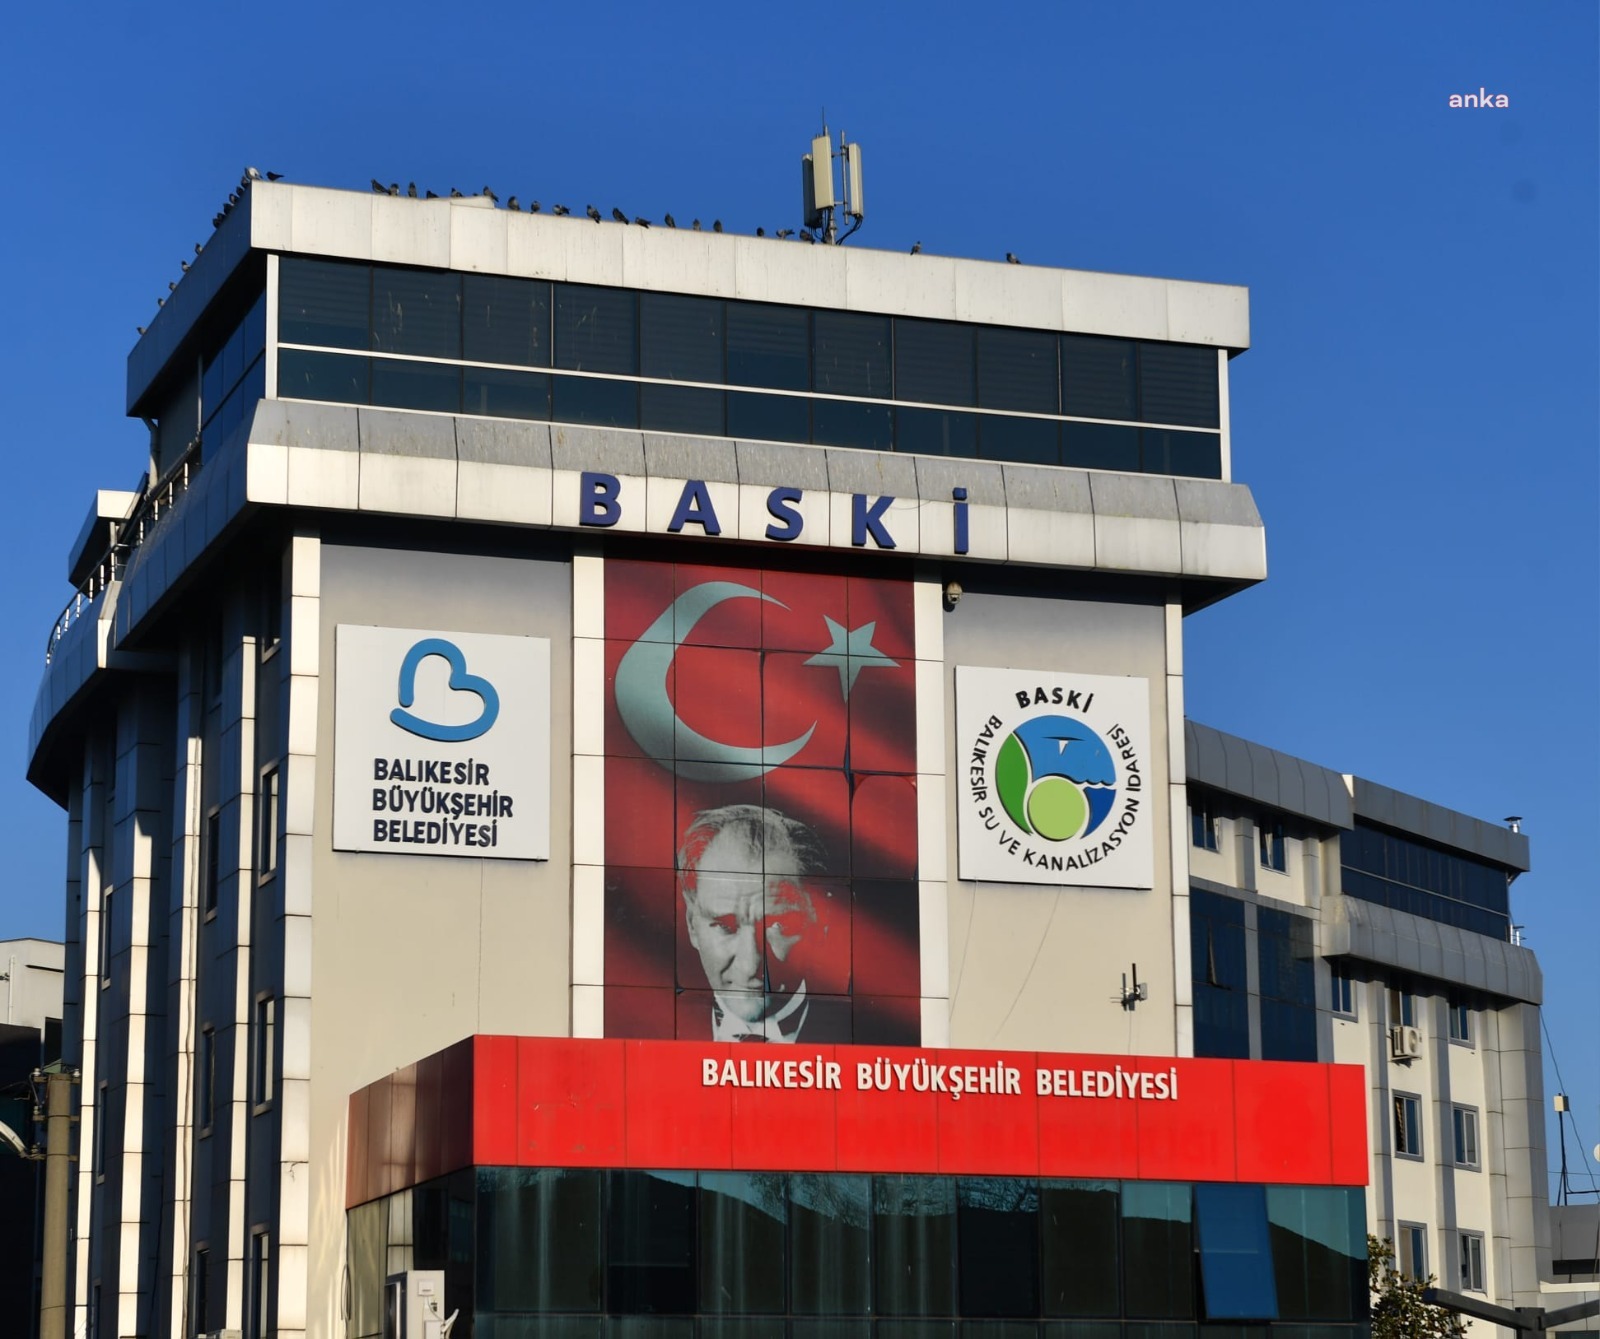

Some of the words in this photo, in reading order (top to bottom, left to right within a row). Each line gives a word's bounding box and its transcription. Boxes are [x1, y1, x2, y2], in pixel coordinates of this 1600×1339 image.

[579, 471, 970, 554] BASKİ
[373, 758, 490, 785] BALIKESİR
[372, 785, 514, 820] BÜYÜKŞEHİR
[373, 817, 498, 847] BELEDİYESİ
[979, 806, 1000, 831] SU
[999, 830, 1021, 855] VE
[702, 1055, 842, 1090] BALIKESİR
[857, 1057, 1021, 1100] BÜYÜKŞEHİR
[1036, 1065, 1179, 1100] BELEDİYESİ
